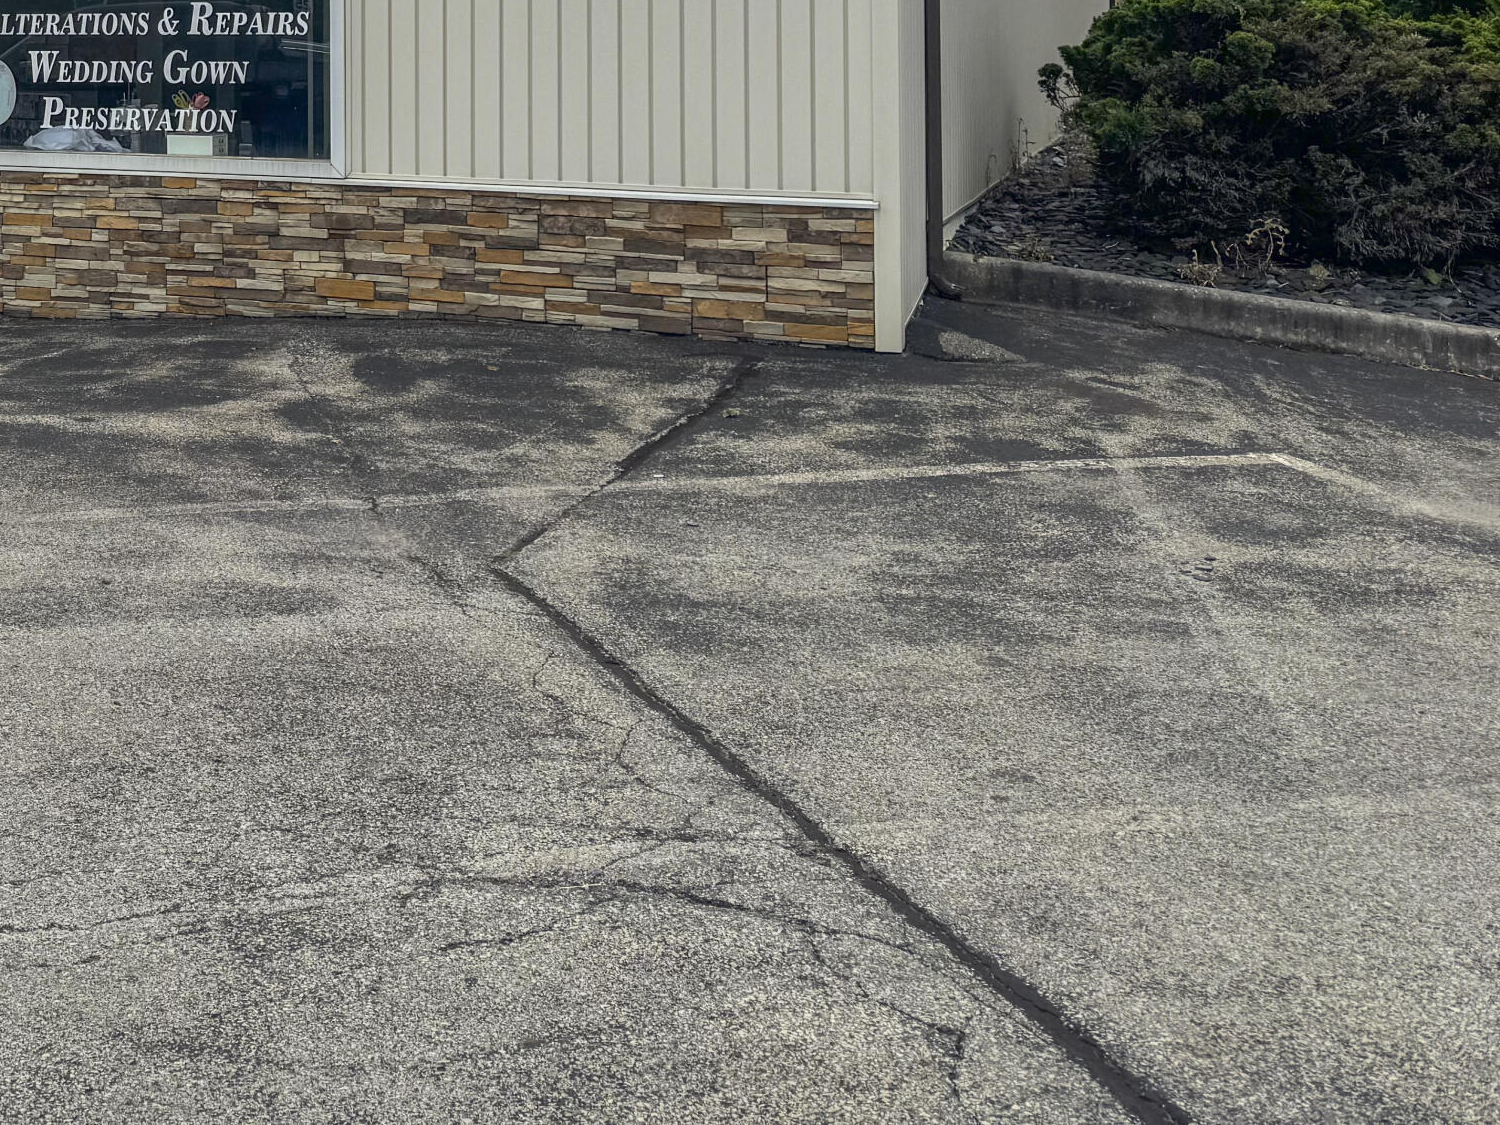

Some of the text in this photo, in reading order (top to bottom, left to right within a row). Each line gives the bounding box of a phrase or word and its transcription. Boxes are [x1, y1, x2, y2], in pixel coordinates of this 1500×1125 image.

[157, 7, 179, 36] &
[186, 1, 310, 36] REPAIRS
[28, 49, 250, 84] WEDDING GOWN
[40, 96, 238, 133] PRESERVATION
